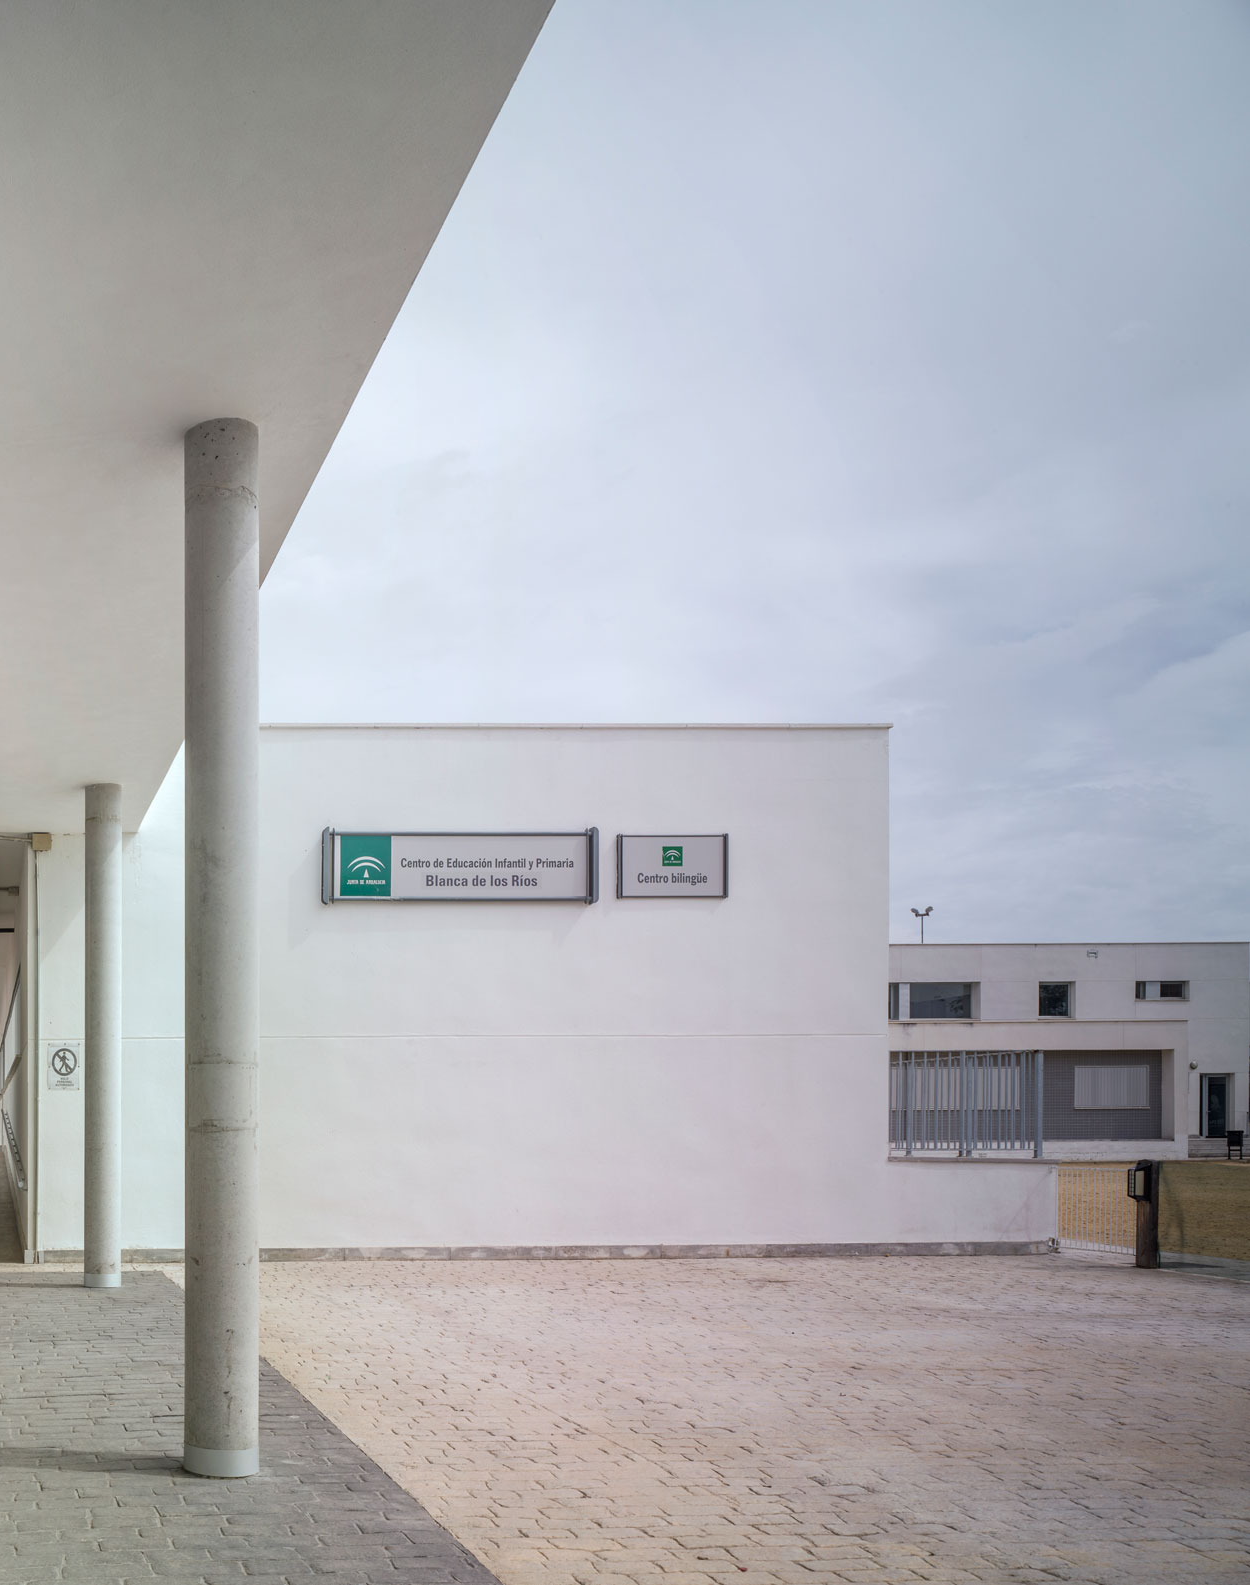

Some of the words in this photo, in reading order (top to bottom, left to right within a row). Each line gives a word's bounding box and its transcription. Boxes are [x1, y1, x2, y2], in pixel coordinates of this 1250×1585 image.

[400, 857, 431, 868] Centro
[433, 857, 444, 868] de
[446, 857, 493, 868] Educación
[495, 857, 526, 868] Infantil
[528, 860, 534, 871] y
[536, 857, 574, 868] Primaria
[426, 874, 468, 887] Blanca
[472, 874, 487, 887] de
[490, 874, 508, 887] los
[512, 874, 538, 887] Ríos
[637, 872, 669, 884] Centro
[671, 872, 708, 886] bilingüe
